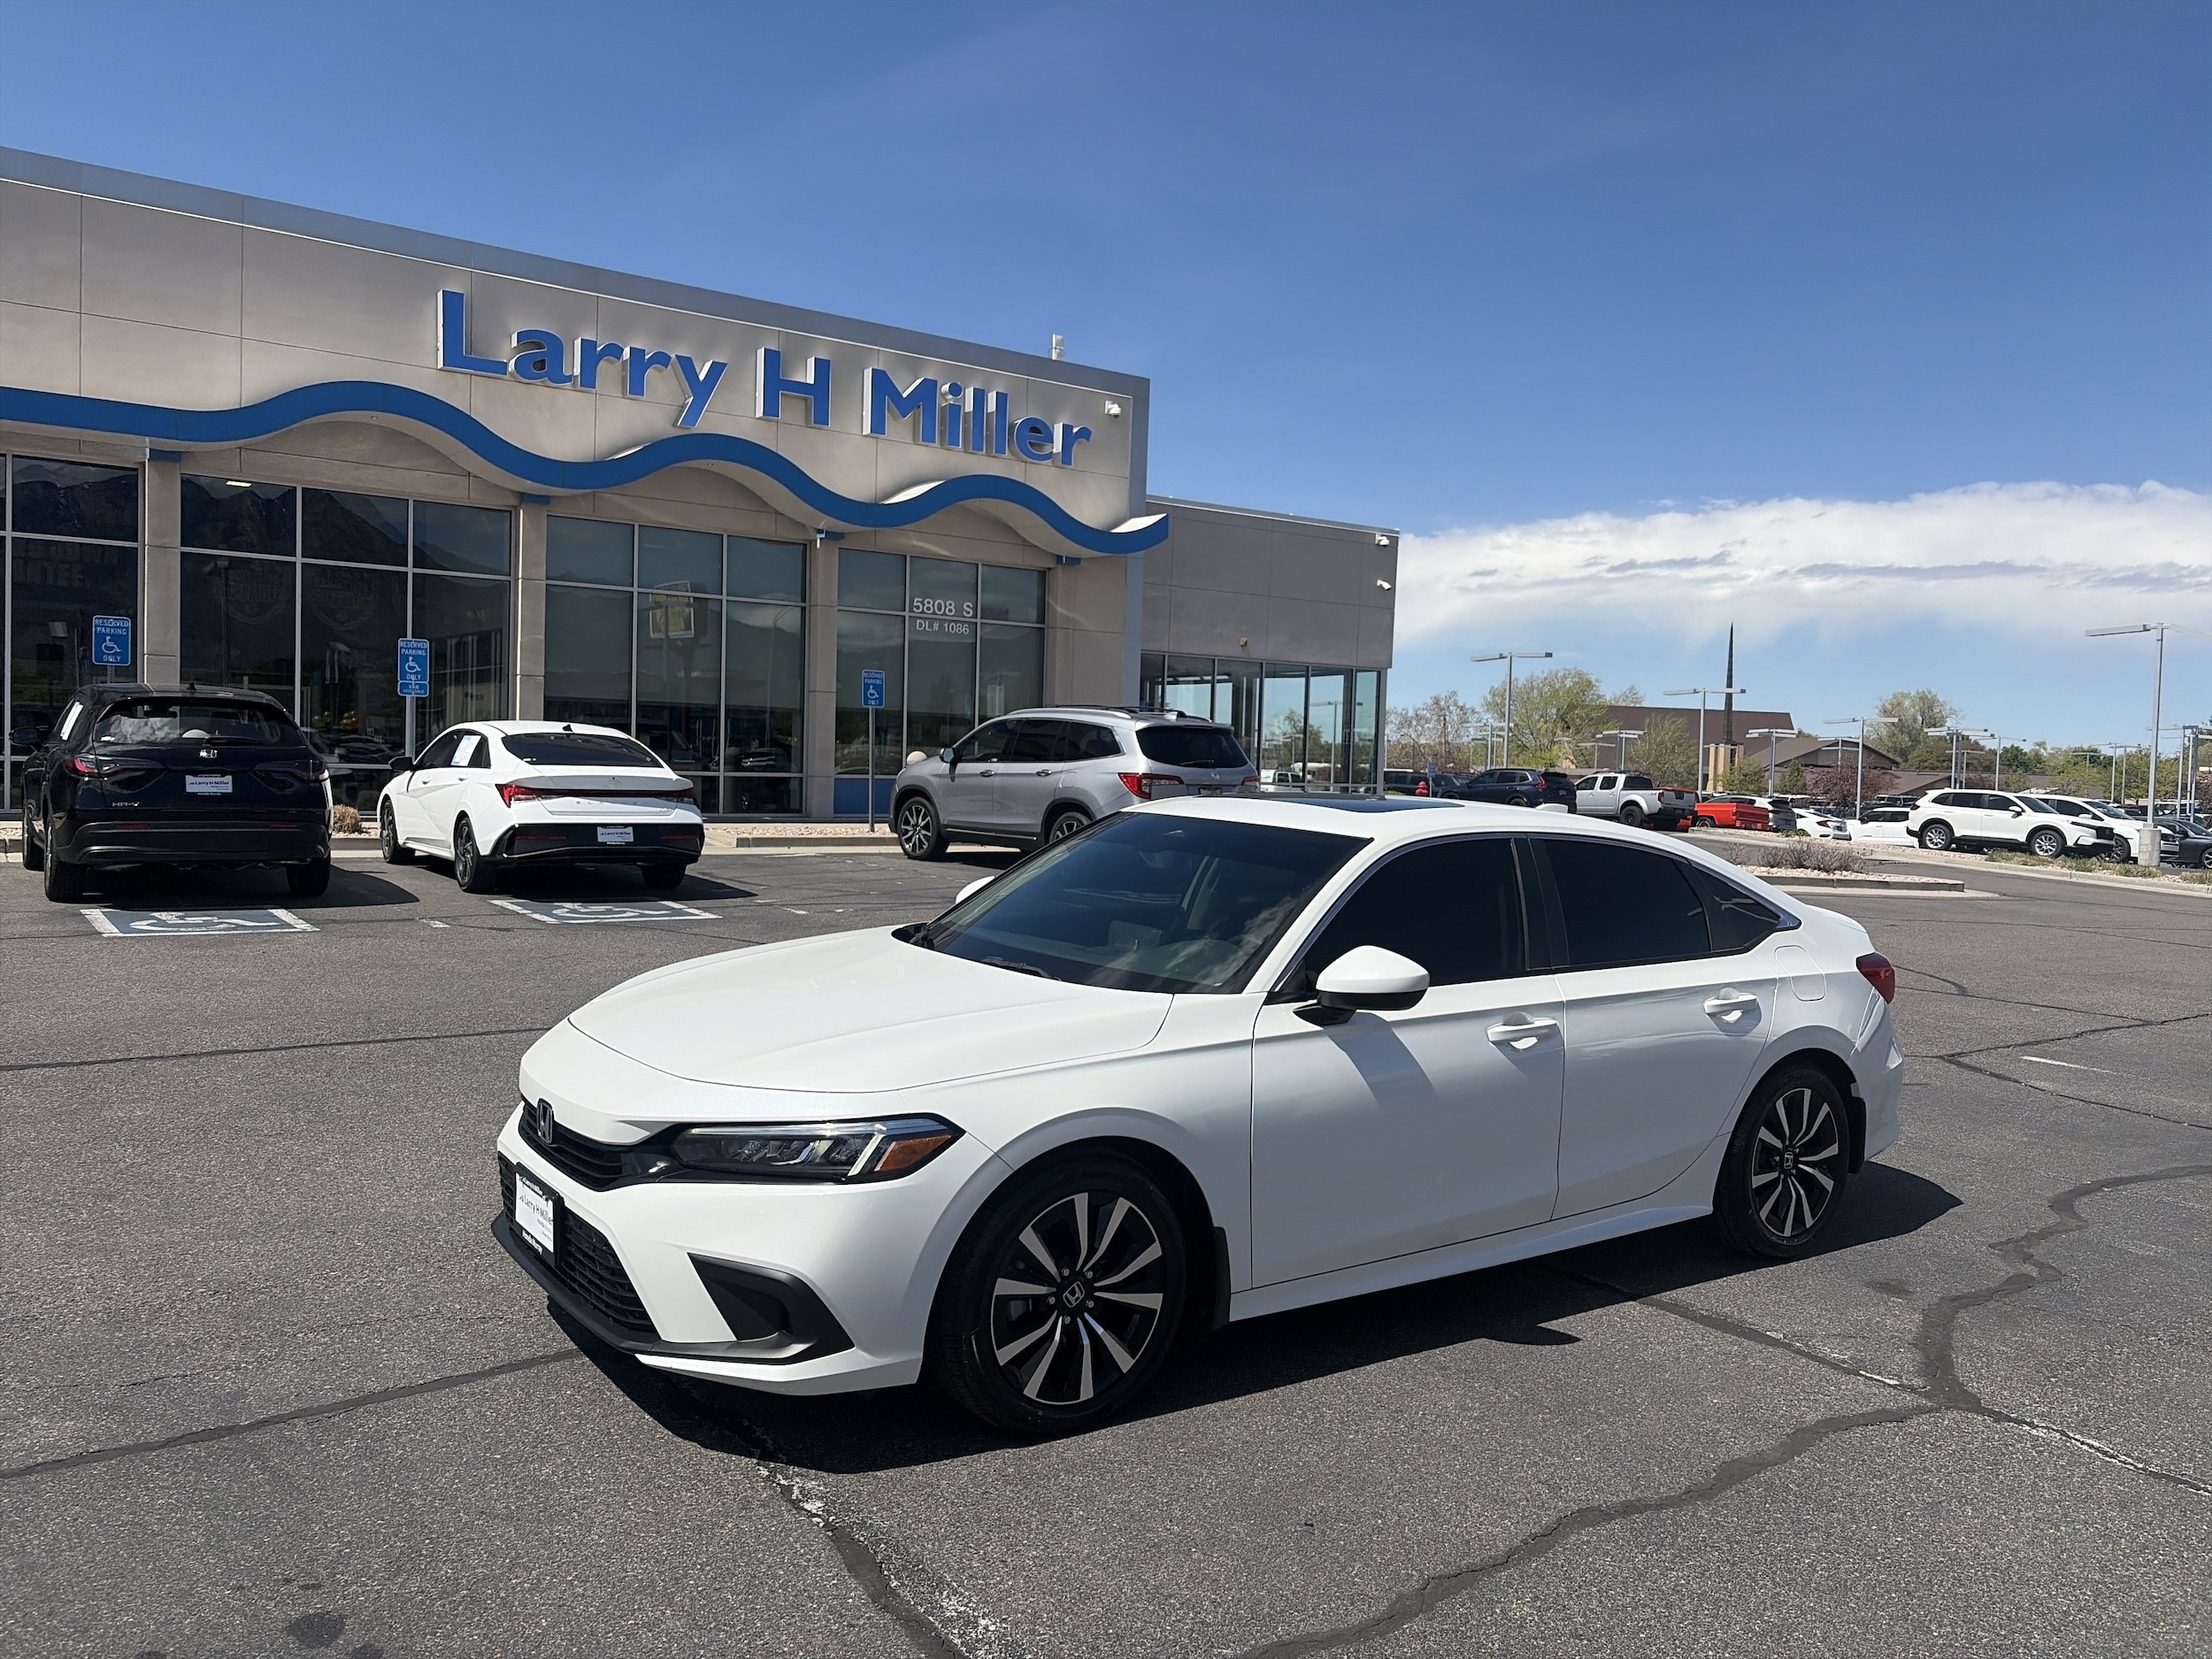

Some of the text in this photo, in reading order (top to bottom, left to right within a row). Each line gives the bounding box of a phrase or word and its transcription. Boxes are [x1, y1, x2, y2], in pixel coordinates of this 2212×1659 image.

[436, 288, 1093, 466] Larry H Miller
[912, 597, 974, 618] 5808 S
[95, 618, 129, 627] RESERVED
[916, 619, 970, 634] DL# 1086
[96, 626, 127, 635] PARKING
